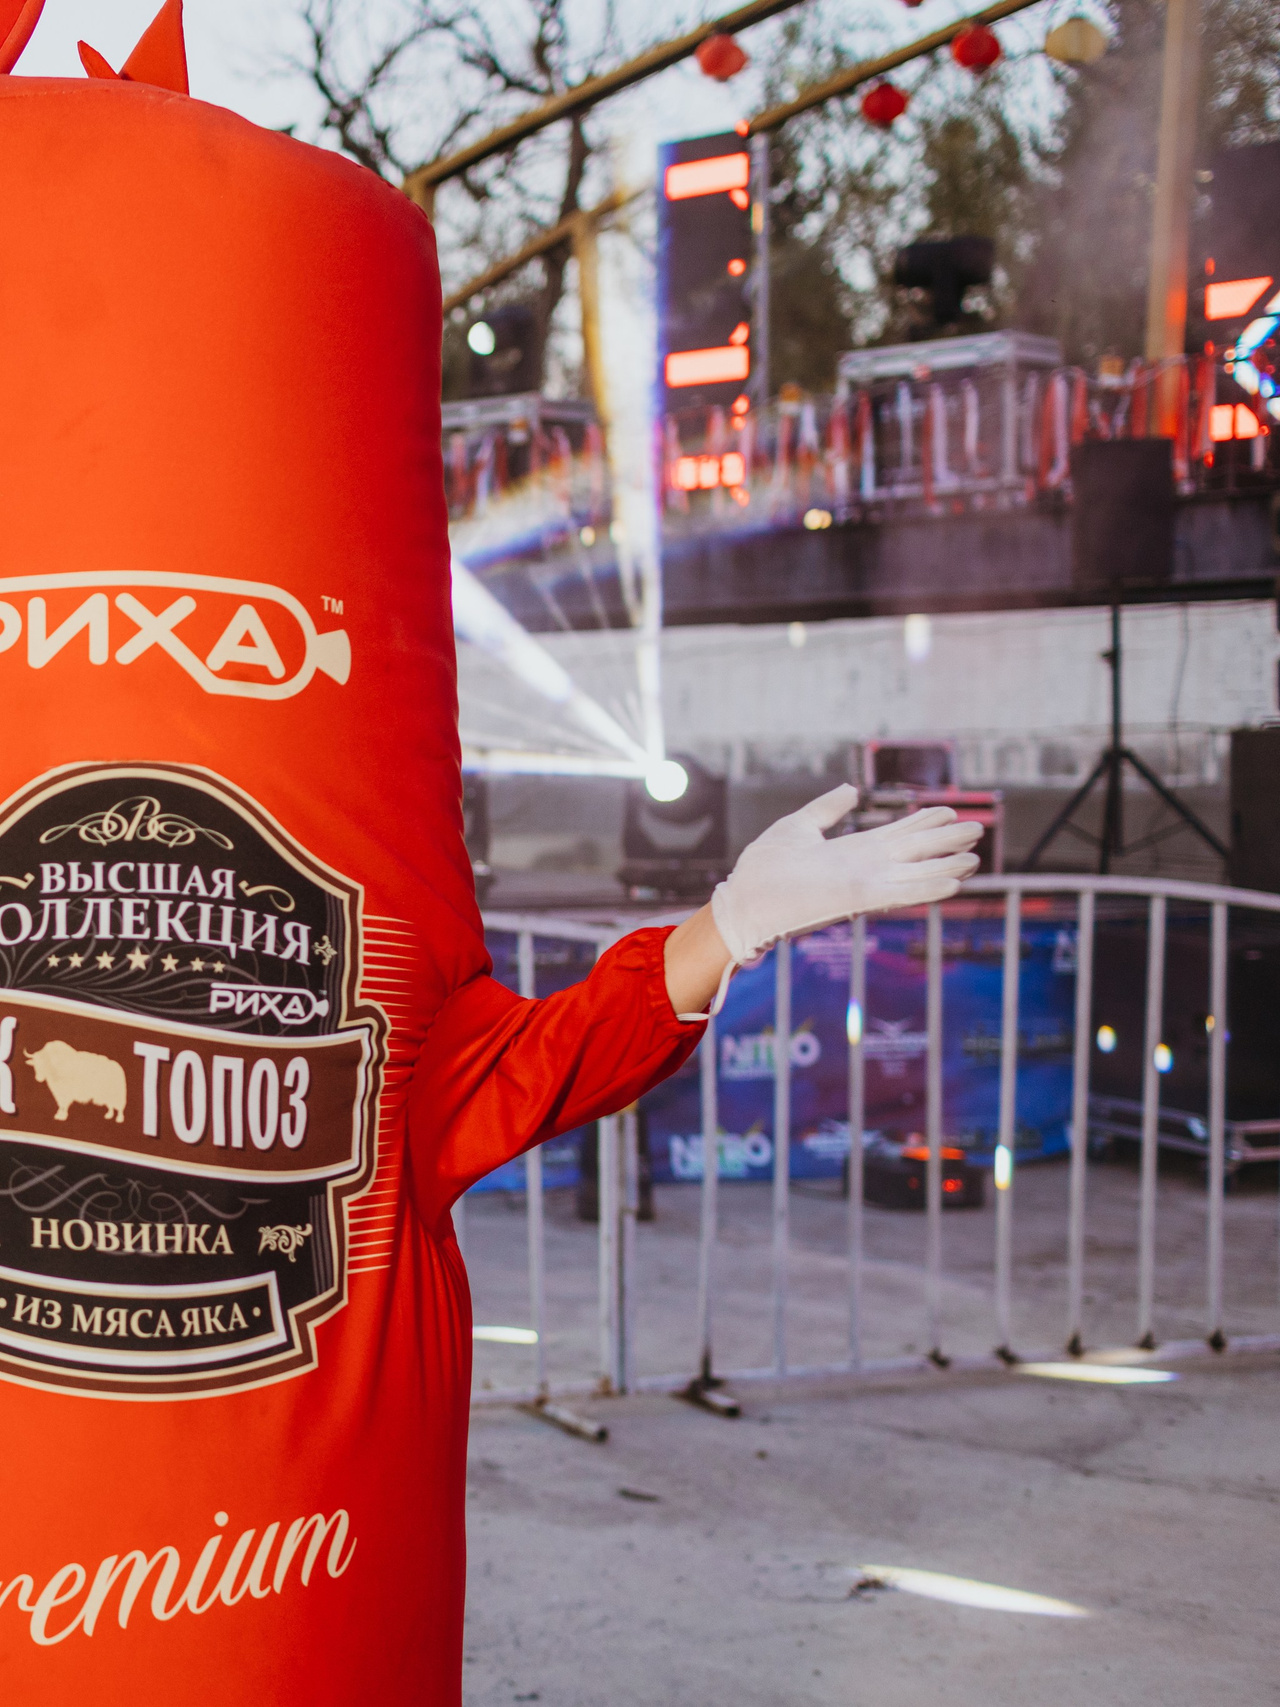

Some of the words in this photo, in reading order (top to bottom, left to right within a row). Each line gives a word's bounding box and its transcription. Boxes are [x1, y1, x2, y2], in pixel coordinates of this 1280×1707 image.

[39, 861, 236, 900] ВЫСШАЯ
[209, 987, 310, 1022] РИХА
[133, 1041, 310, 1151] ТОПОЗ
[672, 1132, 772, 1168] NRO
[31, 1217, 234, 1255] НОВИНКА
[12, 1293, 63, 1330] ИЗ
[70, 1303, 176, 1339] МЯСА
[181, 1302, 249, 1338] ЯКА
